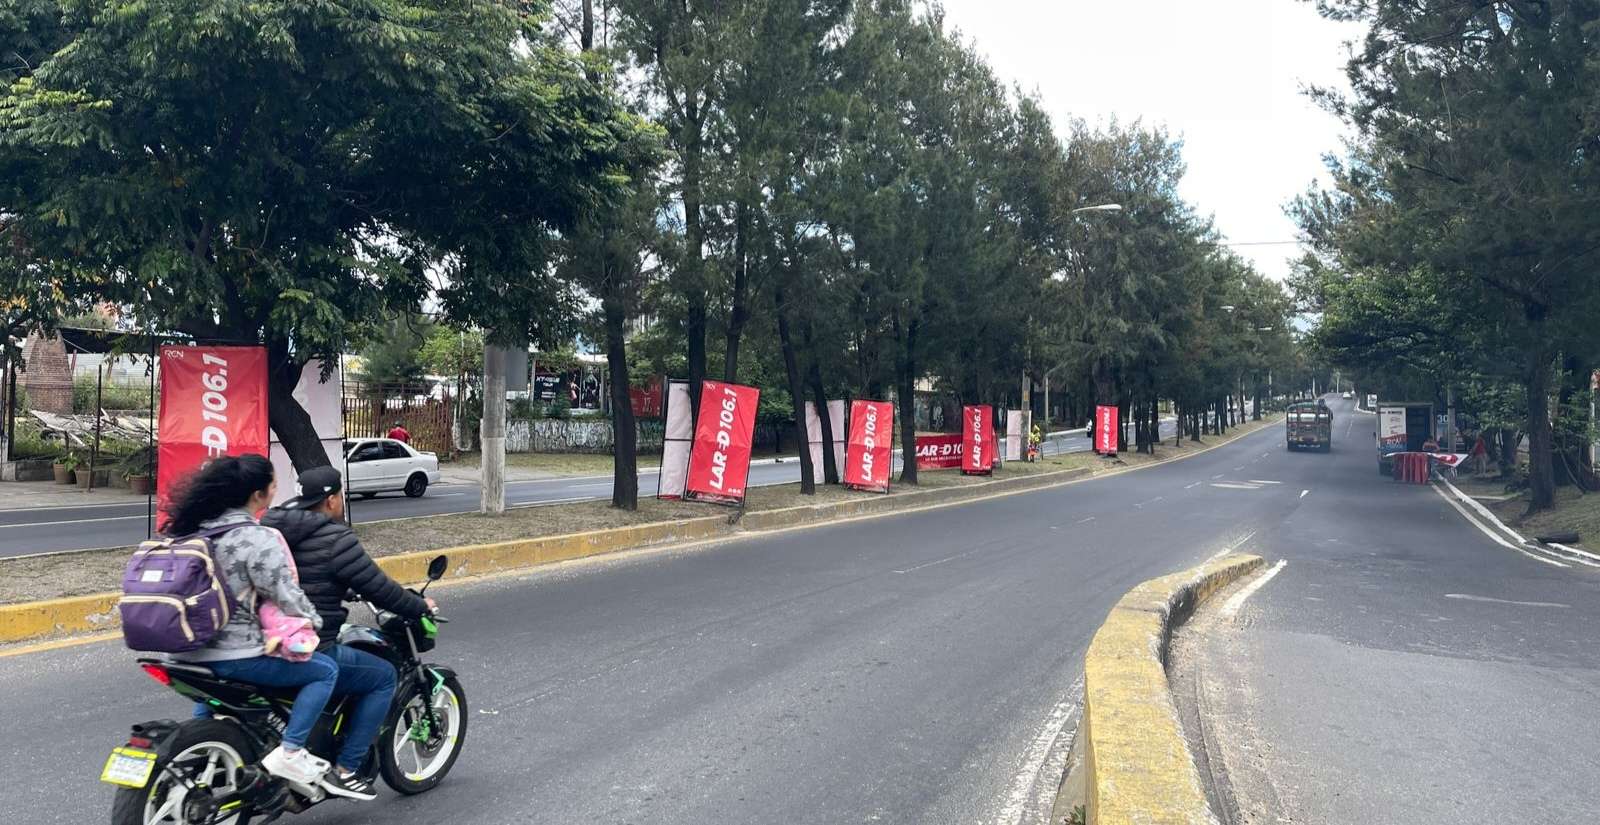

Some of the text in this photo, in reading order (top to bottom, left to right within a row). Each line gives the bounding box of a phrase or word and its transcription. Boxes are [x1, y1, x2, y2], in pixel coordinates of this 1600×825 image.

[202, 353, 228, 422] 106.1
[719, 387, 738, 431] 106.1
[864, 404, 878, 437] 106.1
[973, 408, 982, 433] 106.1
